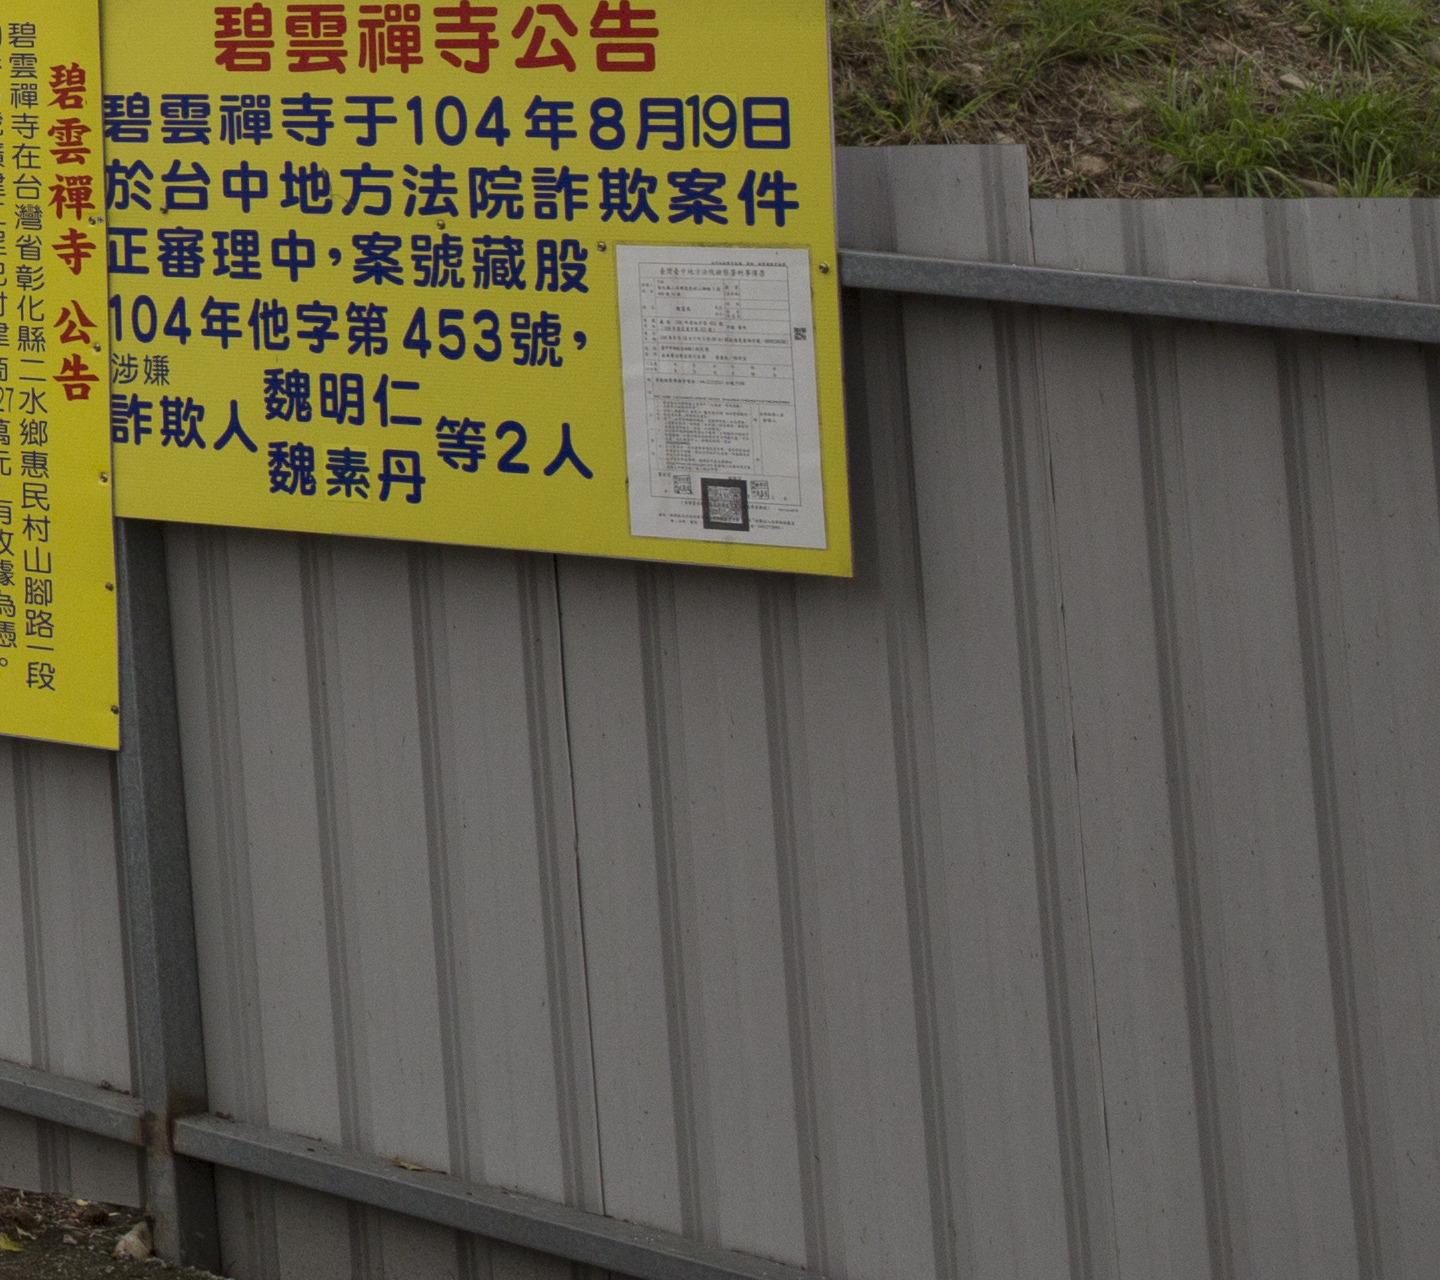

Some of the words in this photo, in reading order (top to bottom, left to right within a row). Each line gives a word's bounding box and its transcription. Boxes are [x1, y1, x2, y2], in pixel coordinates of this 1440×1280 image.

[214, 0, 659, 74] 碧雲禪寺公告
[103, 92, 791, 151] 碧雲禪寺于104年8月19日
[105, 158, 800, 227] 於台中地方法院詐欺案件
[107, 227, 589, 294] 正審理中，案號藏股
[112, 352, 171, 386] 涉嫌
[263, 367, 423, 428] 魏明仁
[112, 393, 257, 454] 詐欺人
[435, 416, 594, 479] 等2人
[268, 441, 426, 504] 魏素丹
